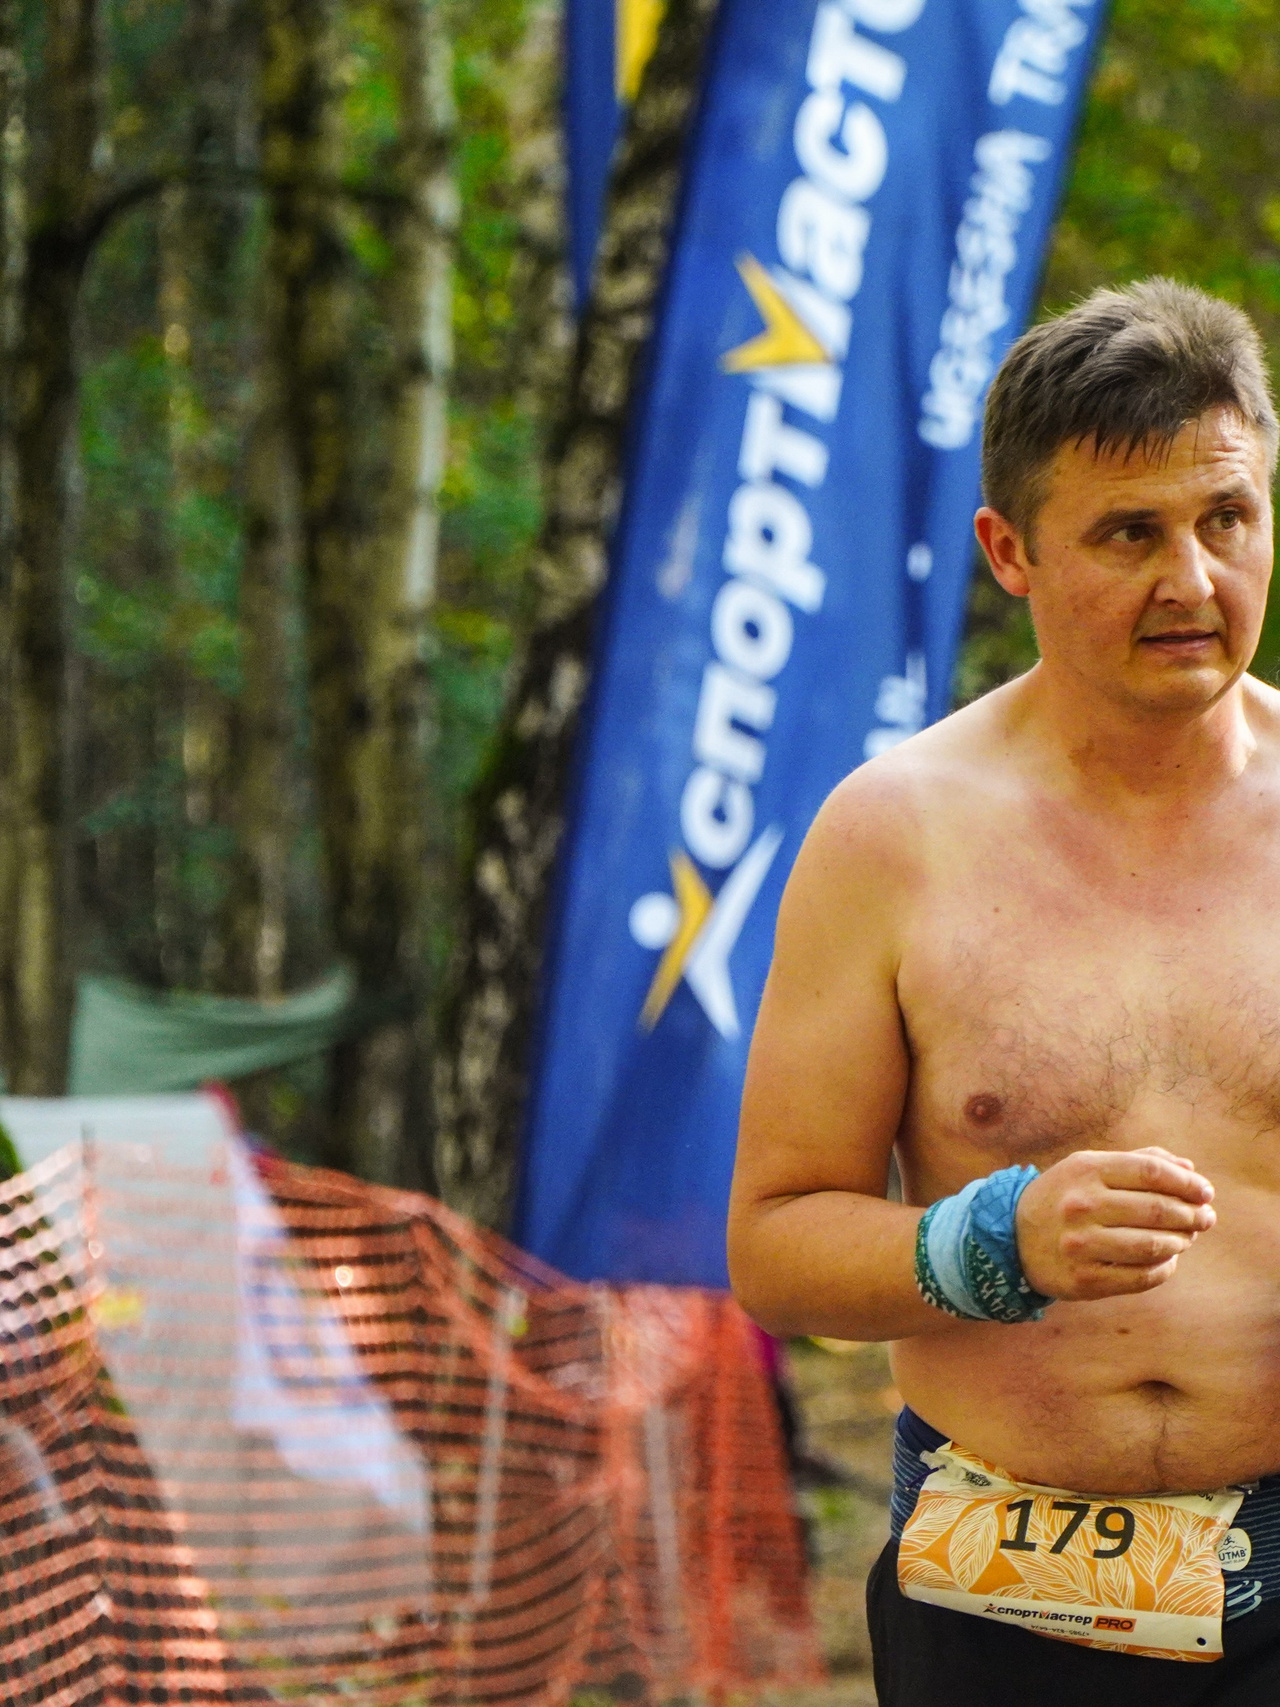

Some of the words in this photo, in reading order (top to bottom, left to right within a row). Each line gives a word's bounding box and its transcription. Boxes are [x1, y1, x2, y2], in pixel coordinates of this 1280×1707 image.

[1000, 1499, 1136, 1560] 179
[1218, 1549, 1246, 1561] UTMB
[1095, 1617, 1134, 1632] PRO
